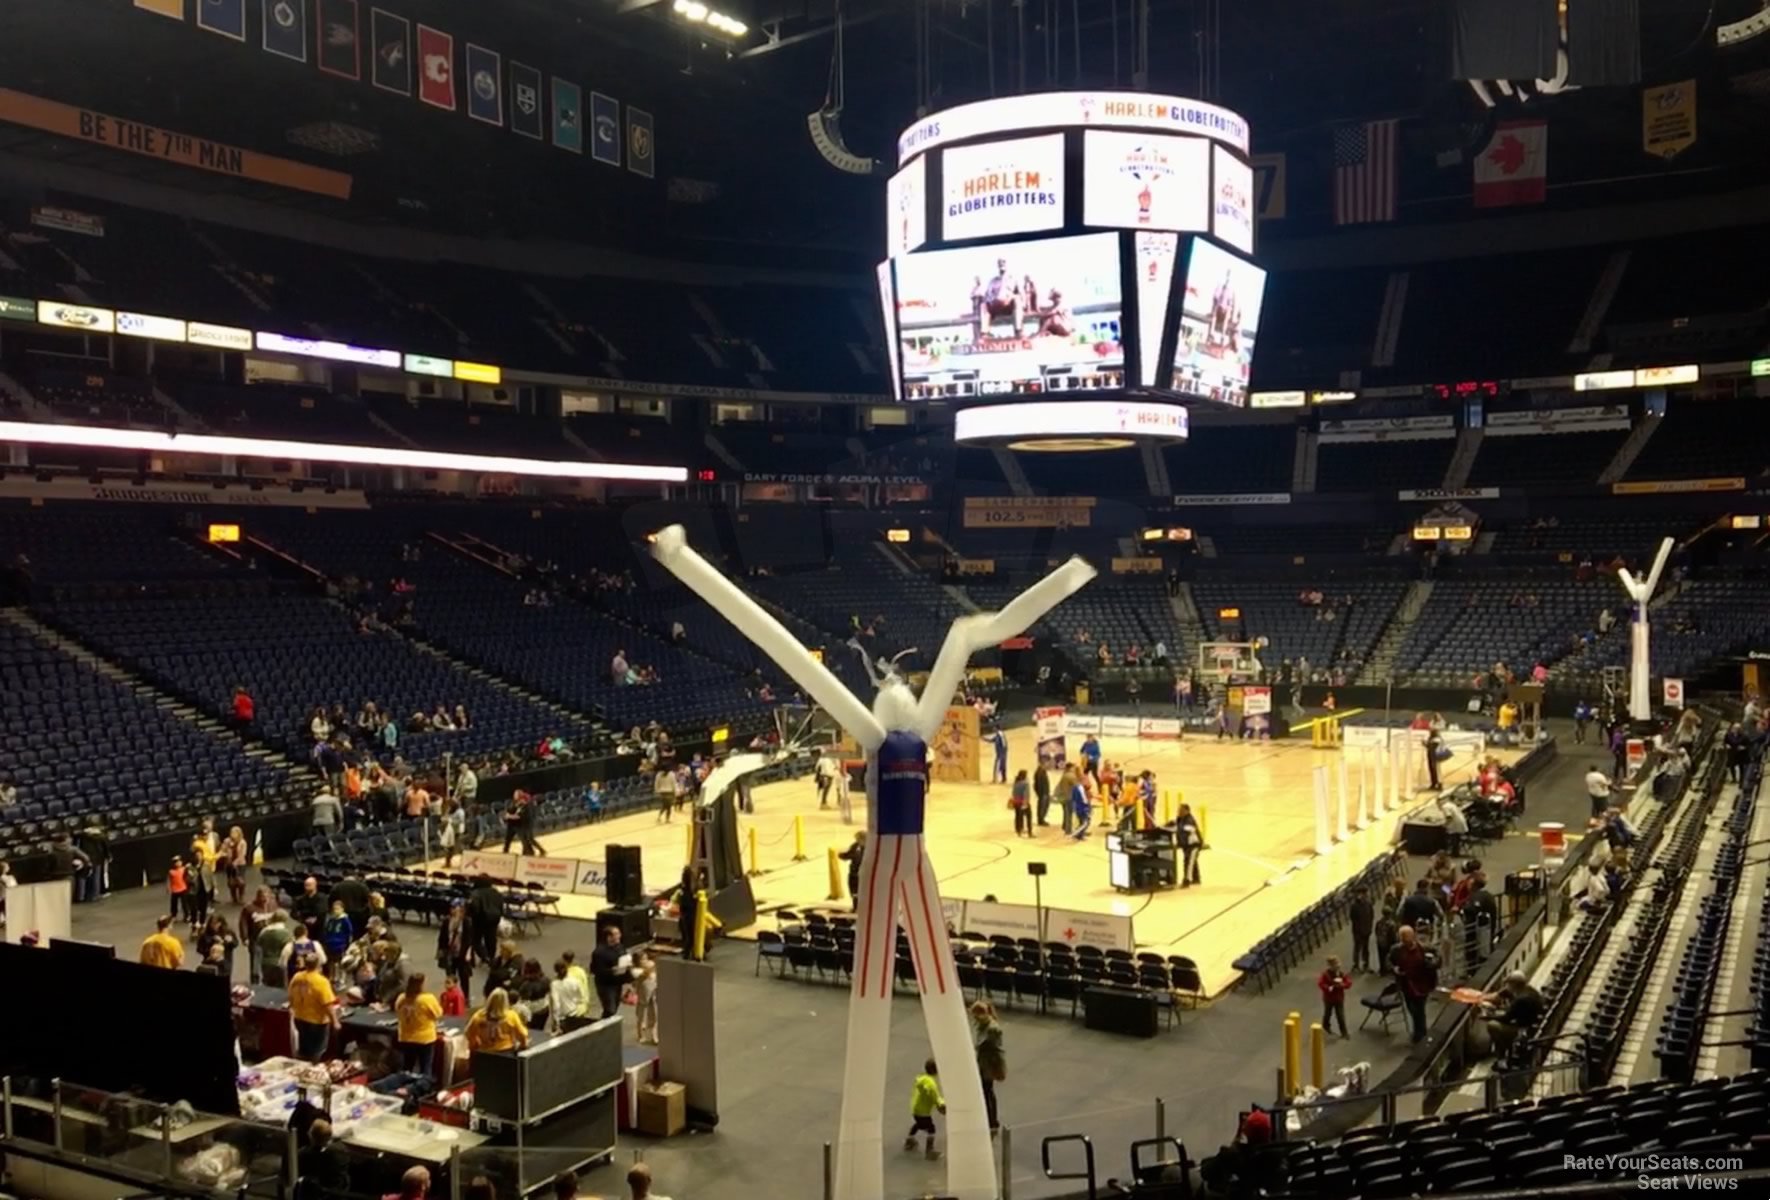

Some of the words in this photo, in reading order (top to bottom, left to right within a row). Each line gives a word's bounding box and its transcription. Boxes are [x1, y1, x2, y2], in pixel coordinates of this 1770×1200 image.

[1104, 101, 1168, 119] HARLEM
[80, 111, 107, 141] BE
[114, 120, 155, 153] THE
[162, 132, 192, 156] 7TH
[199, 141, 243, 173] MAN
[964, 171, 1041, 198] HARLEM
[948, 192, 1056, 217] GLOBETROTTERS
[744, 472, 777, 482] GARY
[782, 474, 822, 483] FORCE
[839, 475, 881, 484] ACURA
[885, 476, 924, 485] LEVEL
[92, 487, 211, 503] BRIDGESTONE
[229, 495, 270, 505] ARENA
[985, 511, 1025, 522] 102.5
